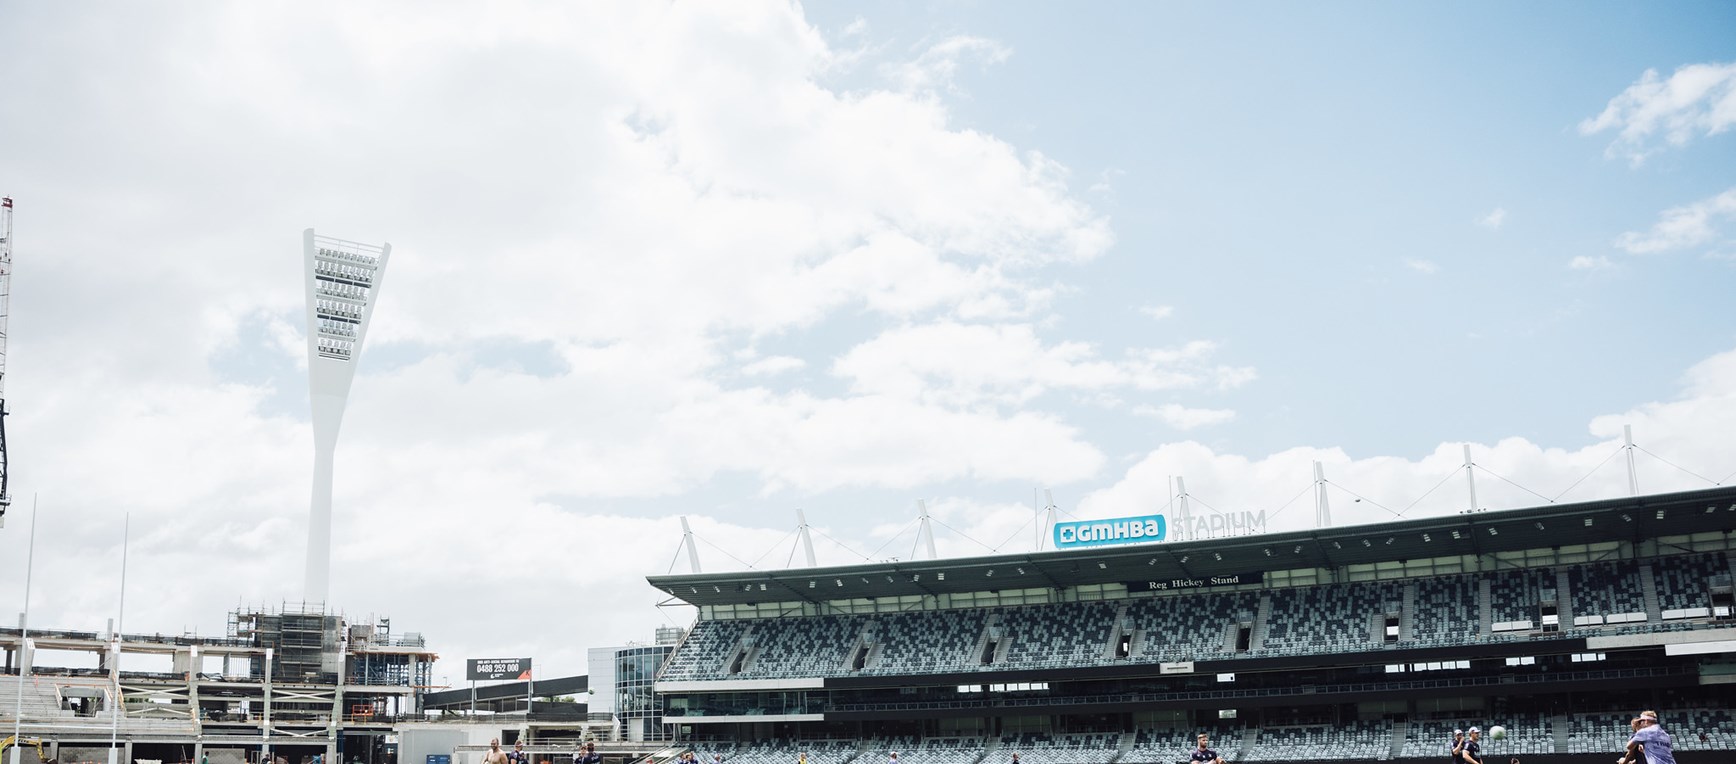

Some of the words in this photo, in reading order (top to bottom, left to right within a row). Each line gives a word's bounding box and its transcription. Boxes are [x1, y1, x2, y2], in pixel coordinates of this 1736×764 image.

[1172, 510, 1265, 534] STADIUM
[1149, 581, 1167, 590] Reg
[1172, 578, 1205, 588] Hickey
[1210, 575, 1239, 585] Stand
[477, 664, 493, 673] 0488
[494, 664, 506, 672] 252
[507, 663, 519, 672] 000
